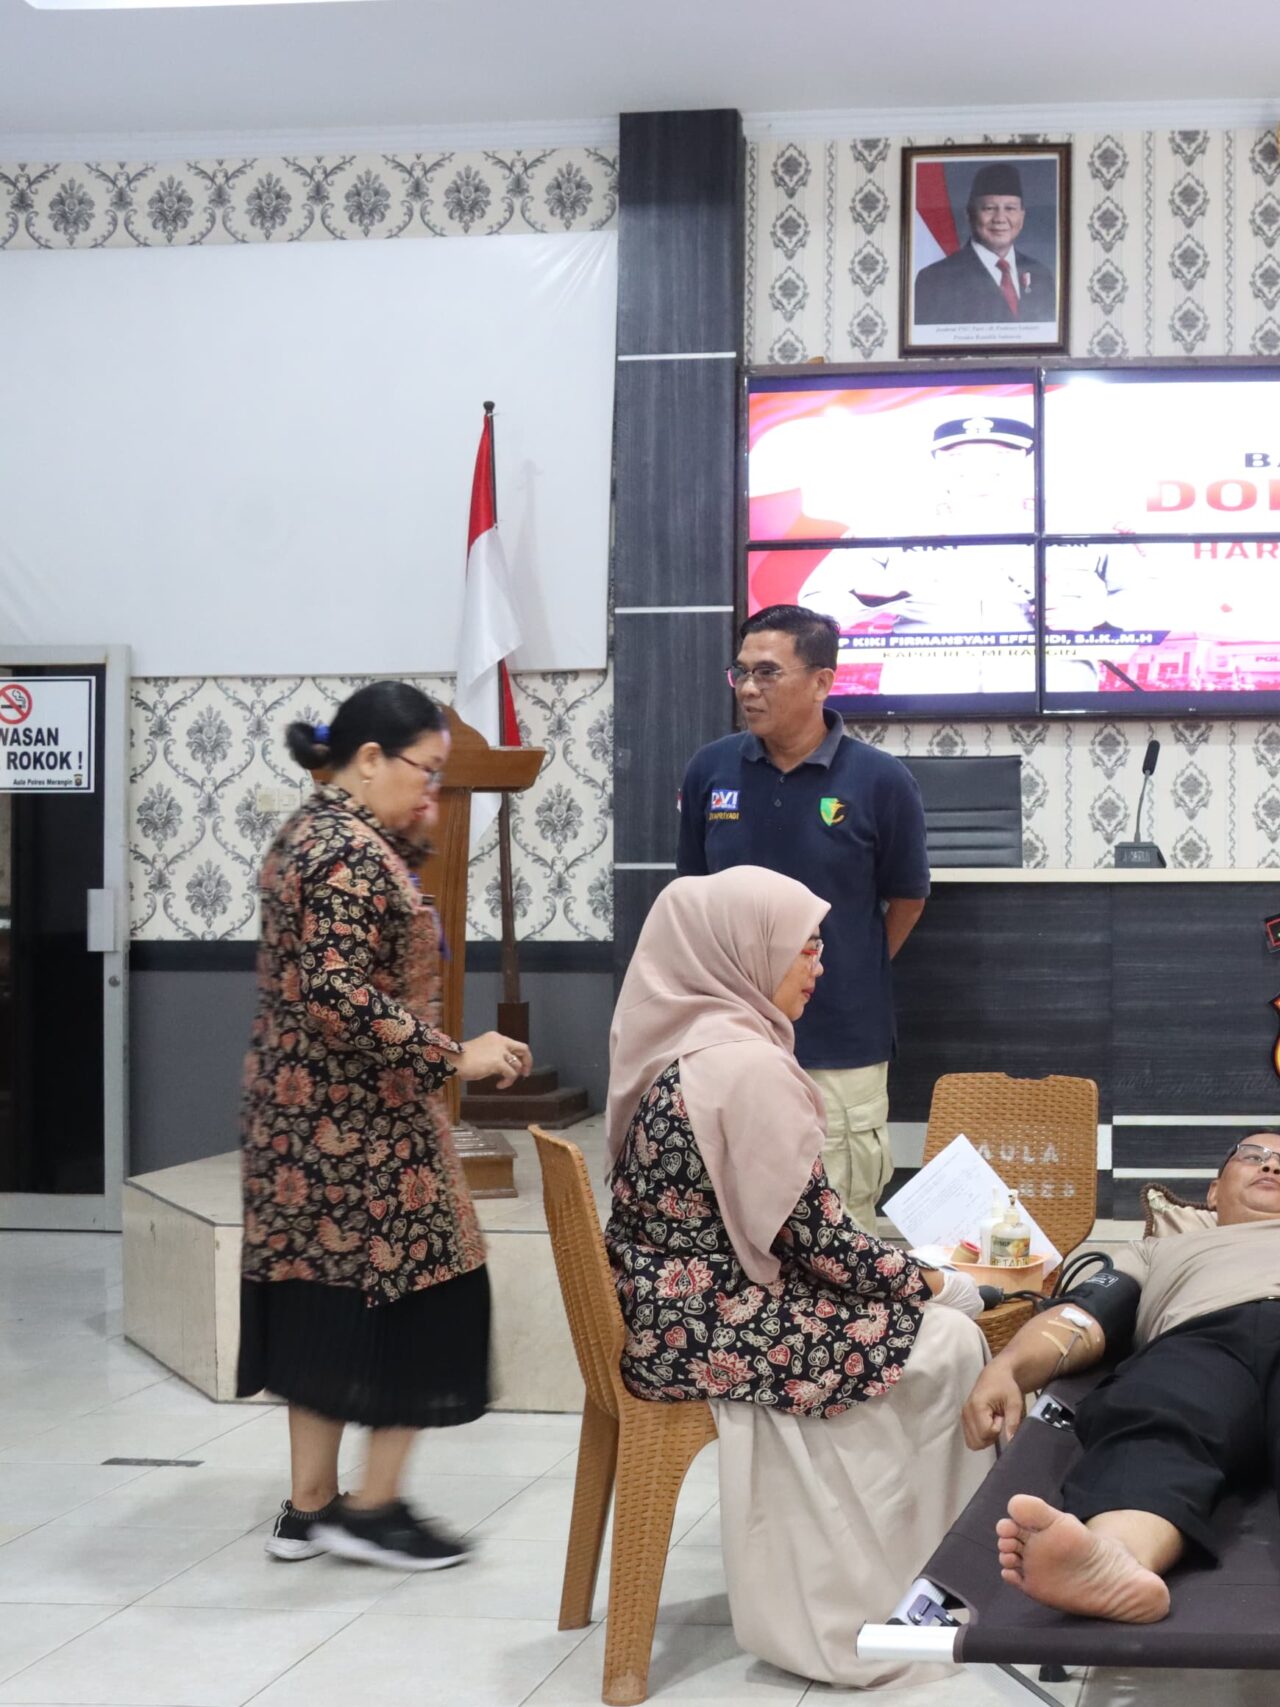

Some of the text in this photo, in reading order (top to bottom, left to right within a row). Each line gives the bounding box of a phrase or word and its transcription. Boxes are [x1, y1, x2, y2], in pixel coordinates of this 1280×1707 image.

[853, 638, 886, 648] KIKI
[889, 635, 996, 647] FIRMANSYAH
[982, 649, 1077, 658] MERAGIN
[7, 751, 72, 770] ROKOK
[711, 791, 739, 805] DVI
[977, 1139, 1060, 1164] AULA
